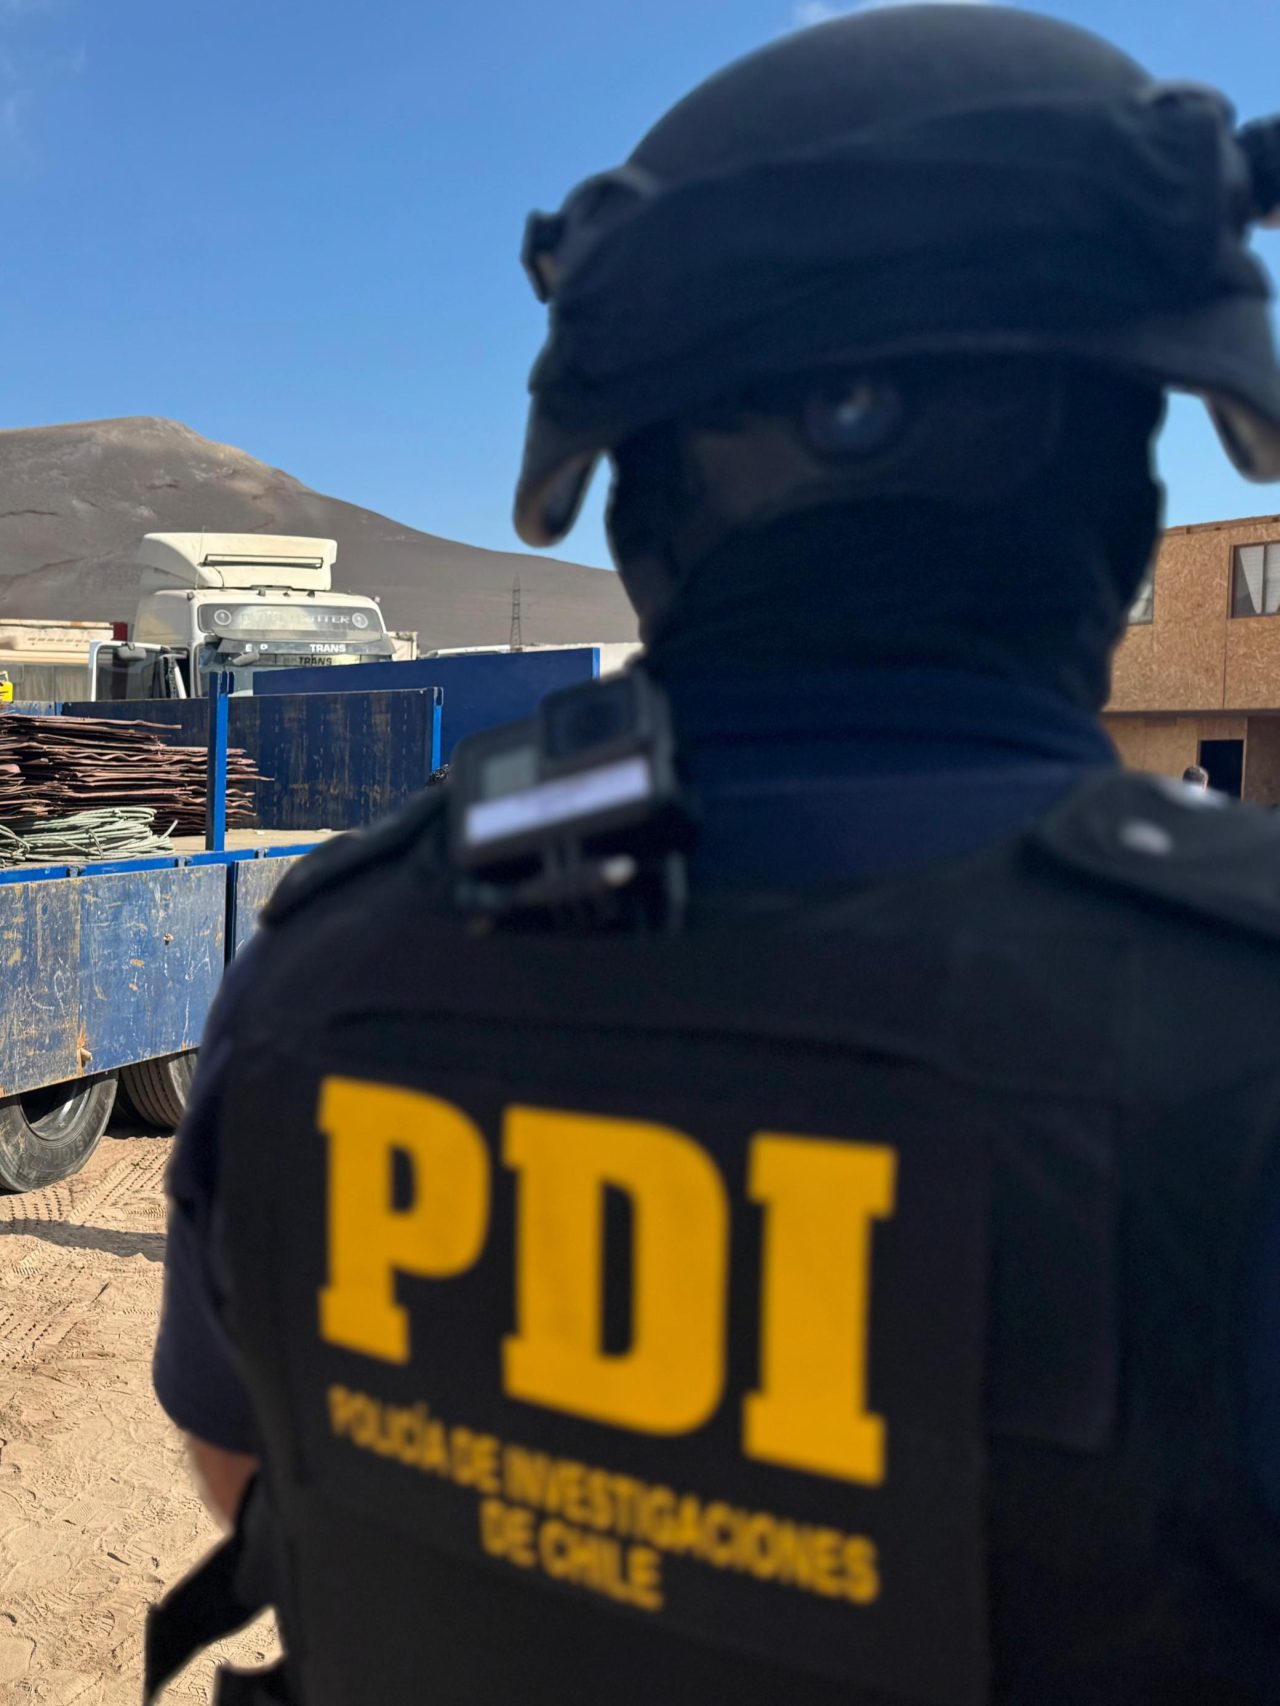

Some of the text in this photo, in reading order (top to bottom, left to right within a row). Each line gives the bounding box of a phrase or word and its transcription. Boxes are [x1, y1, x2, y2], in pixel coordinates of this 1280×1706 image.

[298, 656, 333, 666] TRANS
[309, 643, 346, 653] TRANS
[318, 1076, 897, 1486] PDI
[328, 1386, 878, 1603] POLICÍA DE INVESTIGACIONES
[480, 1498, 663, 1611] DE CHILE
